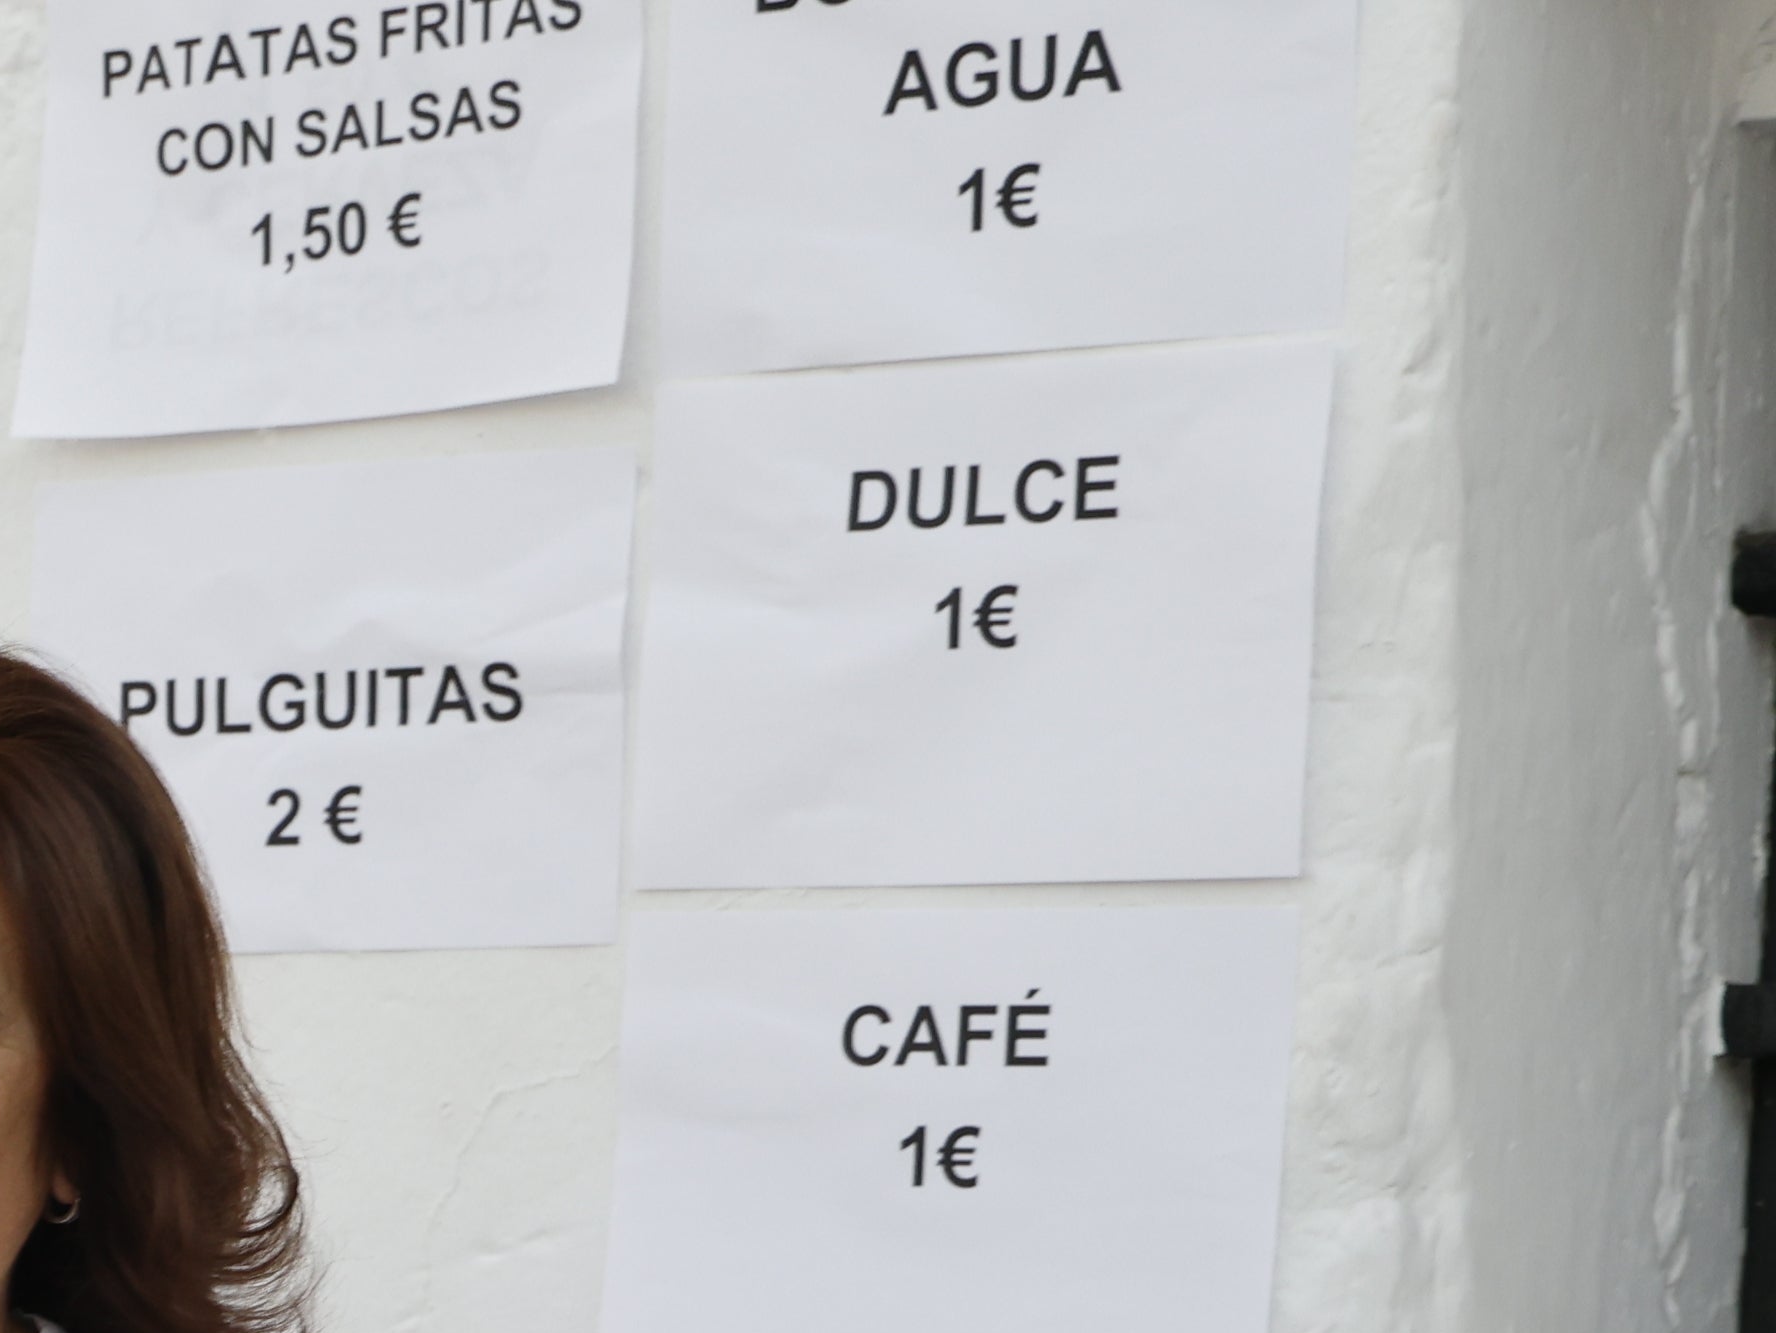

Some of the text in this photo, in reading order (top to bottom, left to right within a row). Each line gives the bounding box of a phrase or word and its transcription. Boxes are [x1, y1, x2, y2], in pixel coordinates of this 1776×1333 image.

[102, 0, 584, 98] PATATAS FRITAS
[882, 28, 1123, 117] AGUA
[156, 80, 523, 176] CON SALSAS
[251, 201, 369, 273] 1,50
[387, 192, 423, 248] €
[956, 161, 1042, 233] 1€
[846, 453, 1122, 534] DULCE
[933, 583, 1021, 651] 1€
[120, 661, 525, 737] PULGUITAS
[264, 783, 365, 848] 2 €
[840, 987, 1054, 1069] CAFÉ
[898, 1124, 983, 1191] 1€
